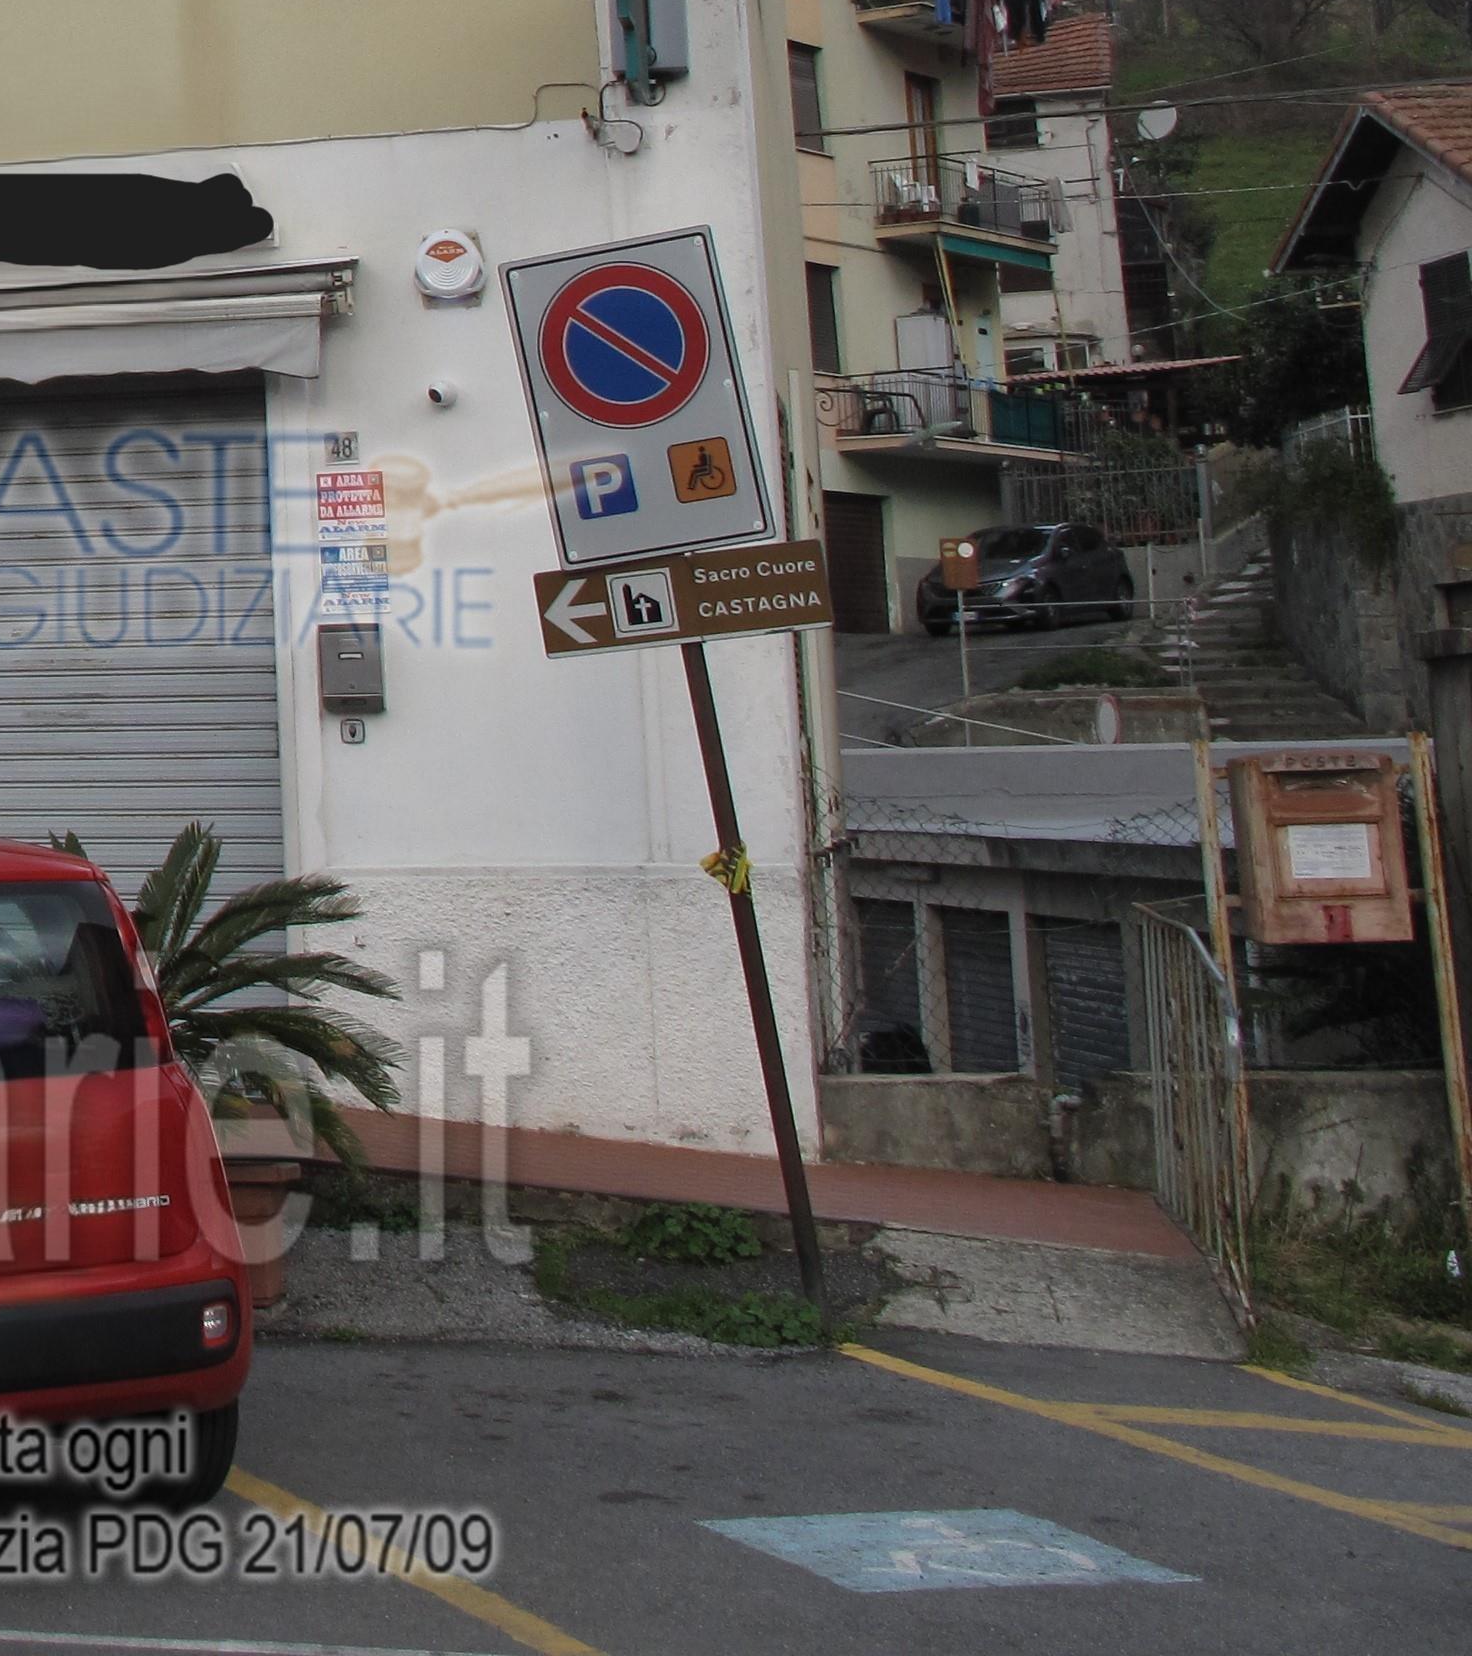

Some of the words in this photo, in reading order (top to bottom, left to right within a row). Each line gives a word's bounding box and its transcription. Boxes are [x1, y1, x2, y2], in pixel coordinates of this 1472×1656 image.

[336, 474, 364, 487] AREA
[581, 462, 622, 514] P
[320, 489, 381, 503] PROTETTA
[320, 505, 335, 518] DA
[336, 504, 384, 517] ALLARME
[319, 524, 387, 533] ALARM
[339, 547, 369, 561] AREA
[693, 567, 750, 584] Sacro
[756, 559, 816, 577] Cuore
[698, 591, 822, 618] CASTAGNA
[1285, 755, 1356, 768] POSTE
